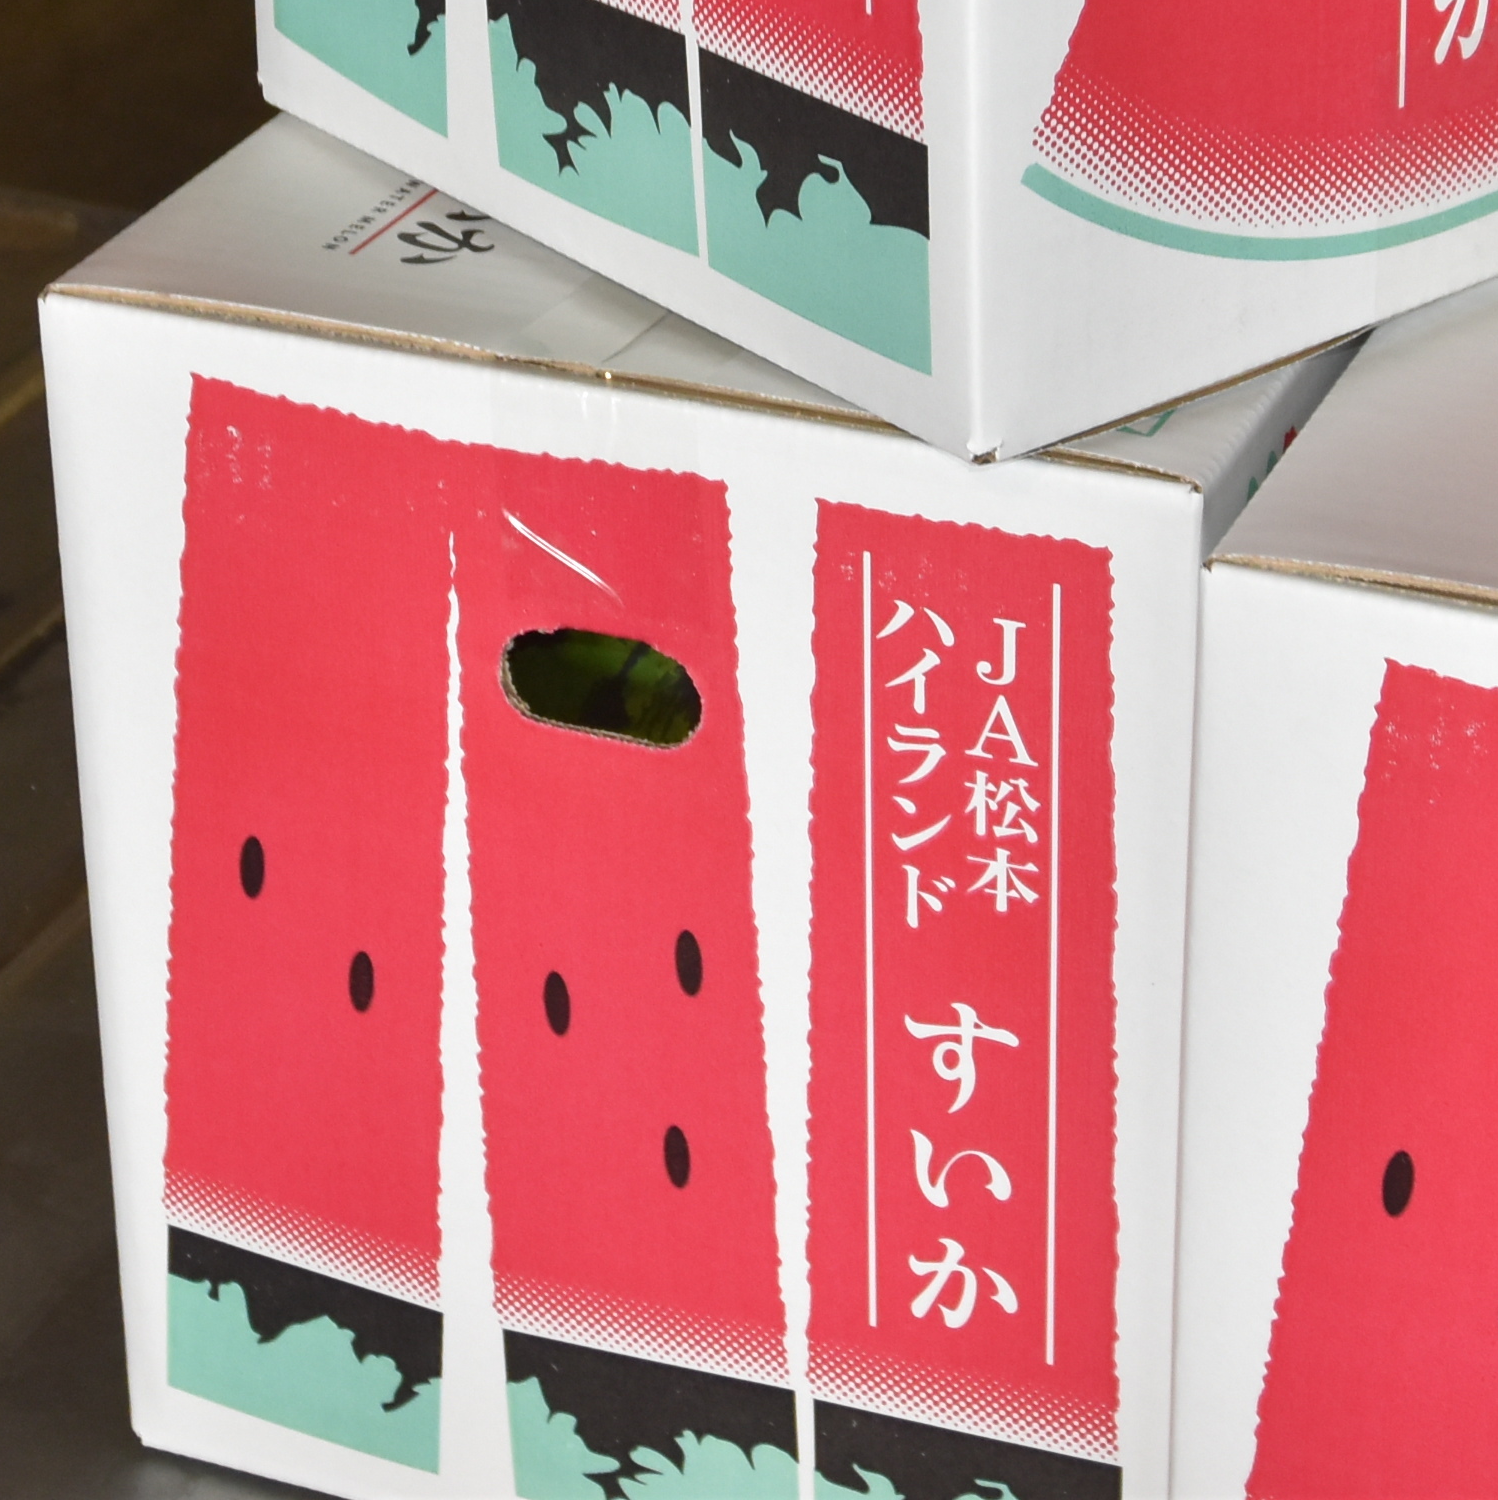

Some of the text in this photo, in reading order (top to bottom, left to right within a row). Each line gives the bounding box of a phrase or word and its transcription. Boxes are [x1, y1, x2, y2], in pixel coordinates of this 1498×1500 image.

[875, 599, 956, 929] ハイランド
[964, 617, 1041, 913] JA松本
[904, 1002, 1020, 1330] すいか
